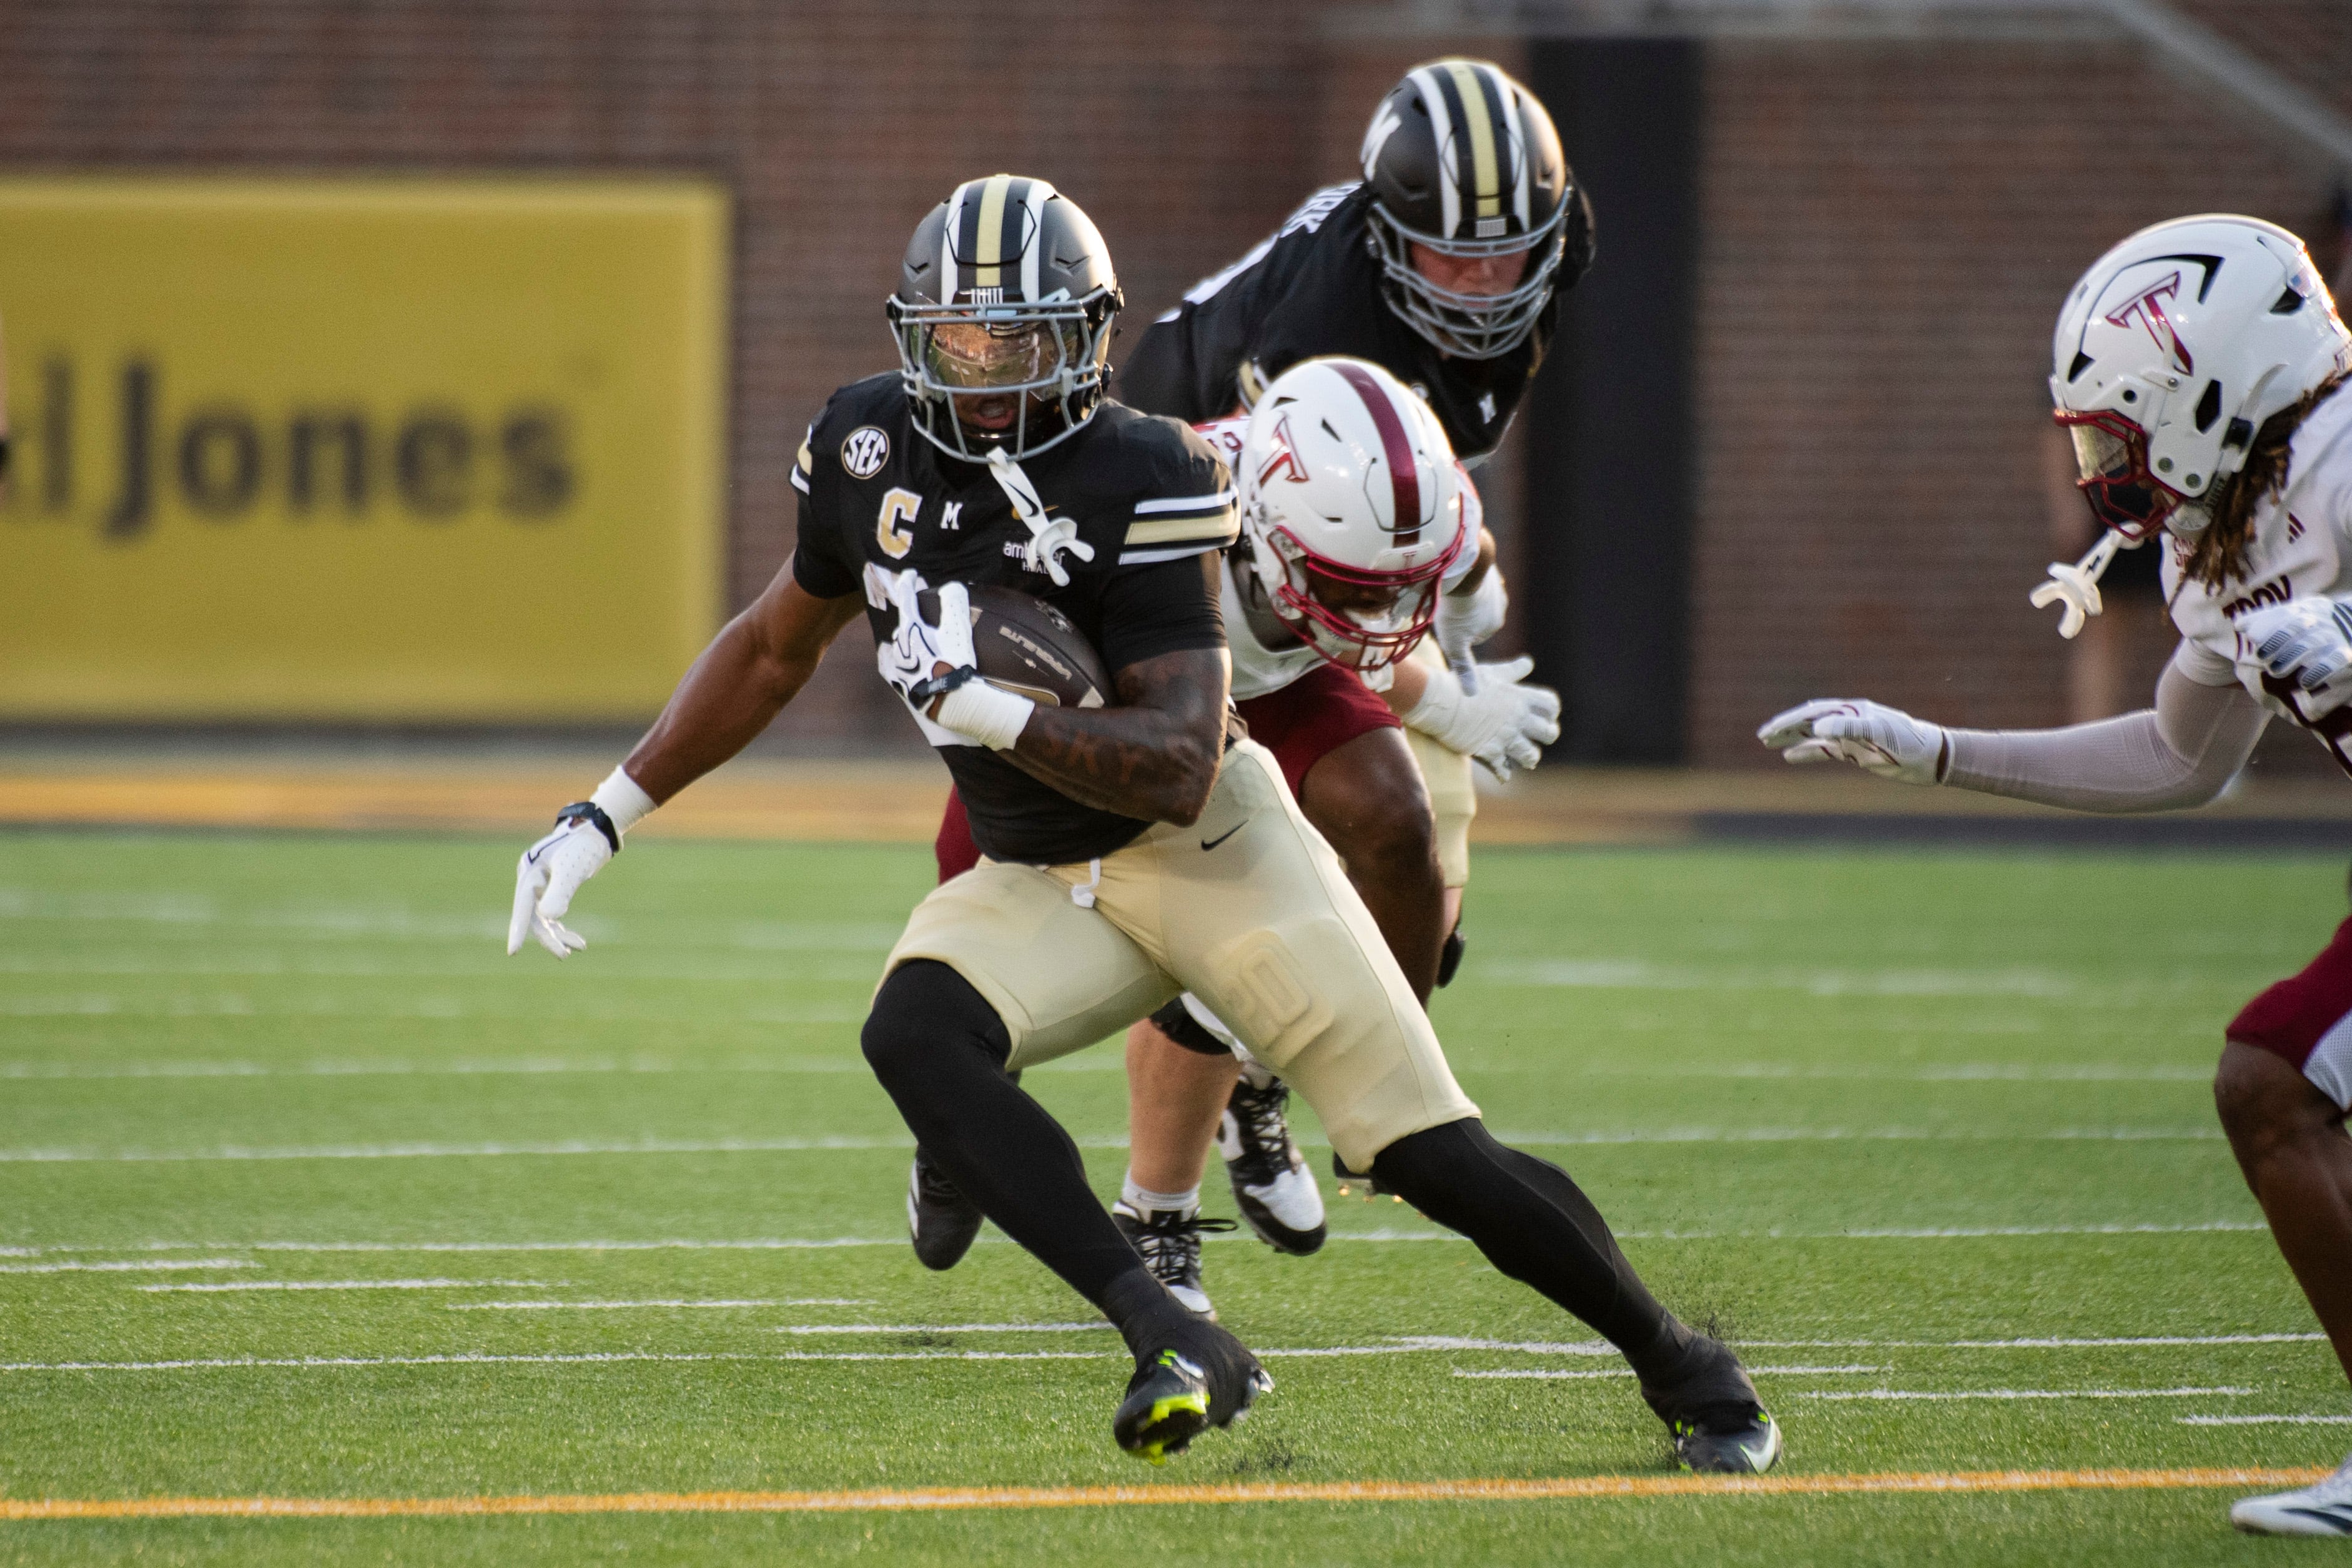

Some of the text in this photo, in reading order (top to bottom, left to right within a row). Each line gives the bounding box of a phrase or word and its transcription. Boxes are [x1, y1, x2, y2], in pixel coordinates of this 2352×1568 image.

[100, 353, 572, 543] Jones
[844, 428, 886, 475] SEC
[876, 486, 923, 560] C
[940, 501, 963, 530] M
